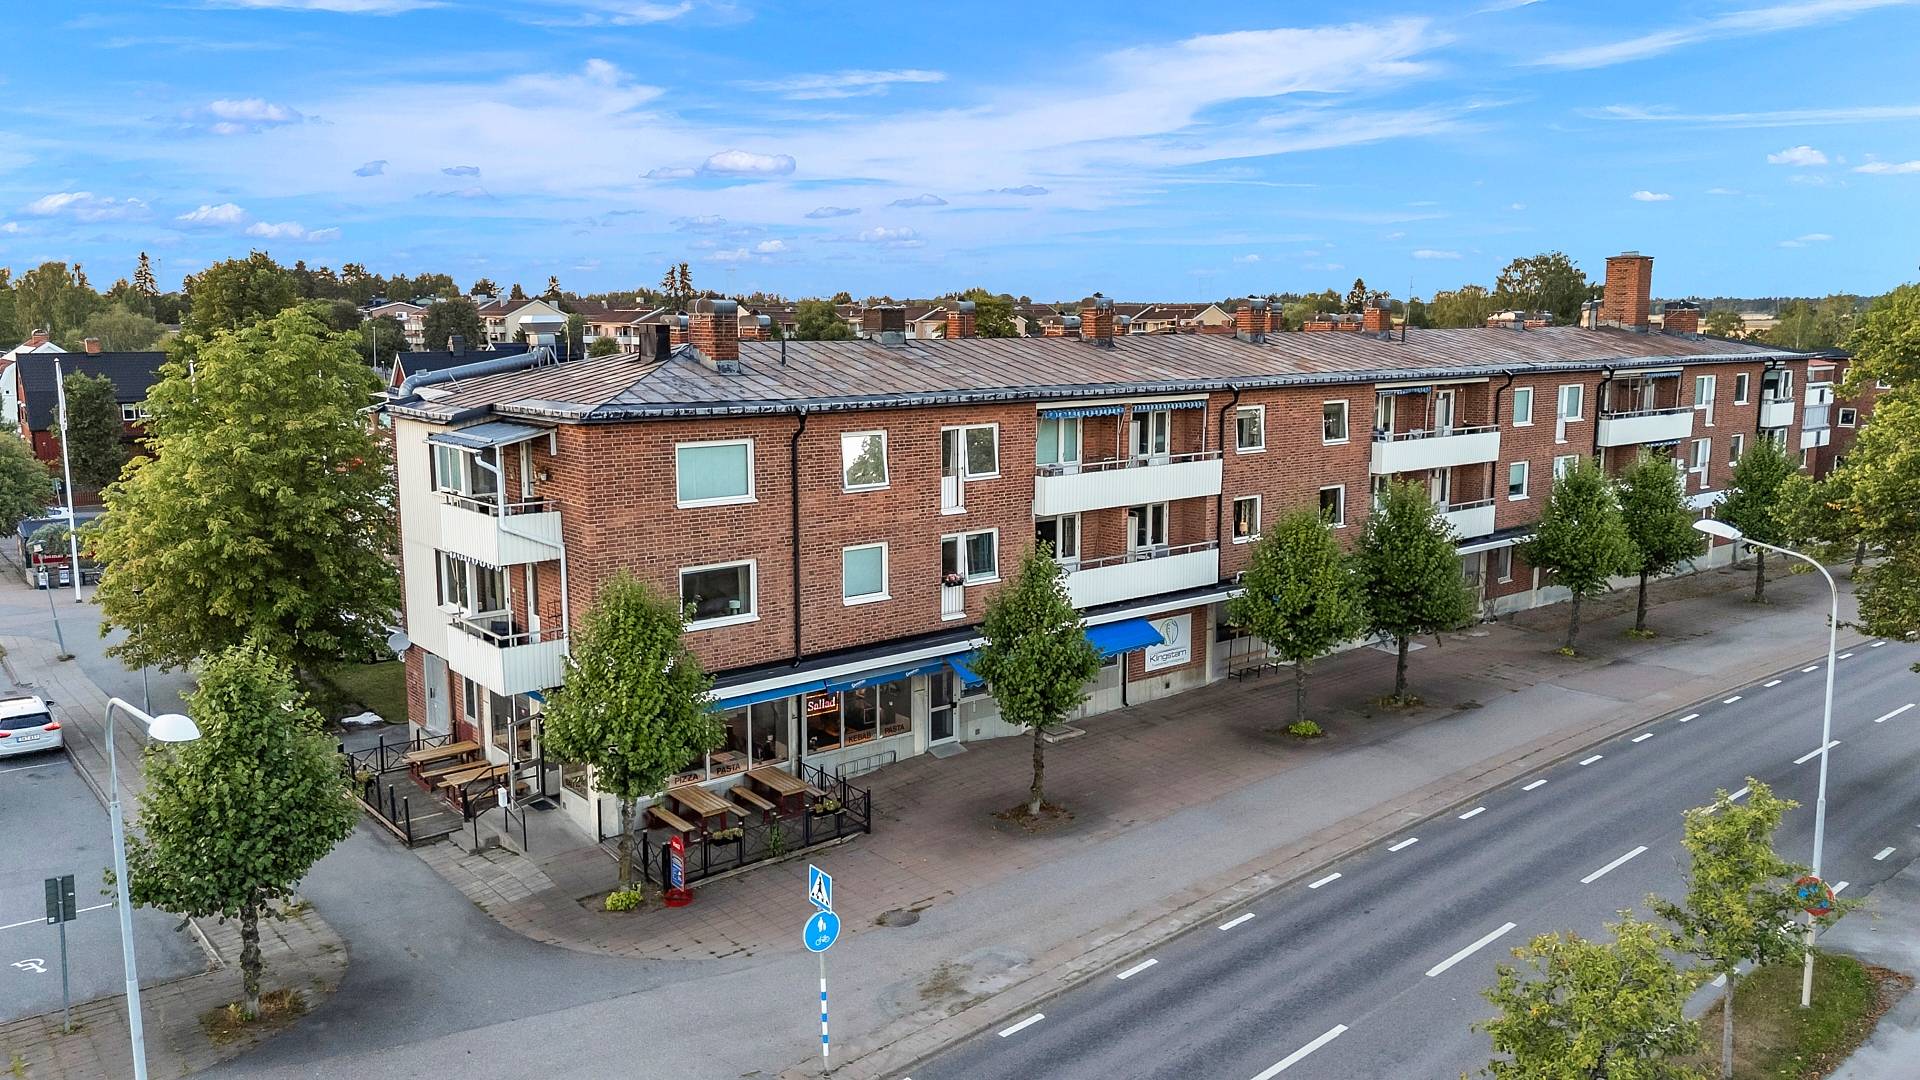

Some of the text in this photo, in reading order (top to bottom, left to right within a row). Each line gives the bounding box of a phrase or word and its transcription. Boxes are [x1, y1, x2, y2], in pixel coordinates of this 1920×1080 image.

[807, 696, 836, 712] Sallad
[884, 723, 905, 735] PASTA
[848, 731, 872, 743] KEBAB
[716, 763, 741, 775] PASTA
[674, 773, 699, 785] PIZZA
